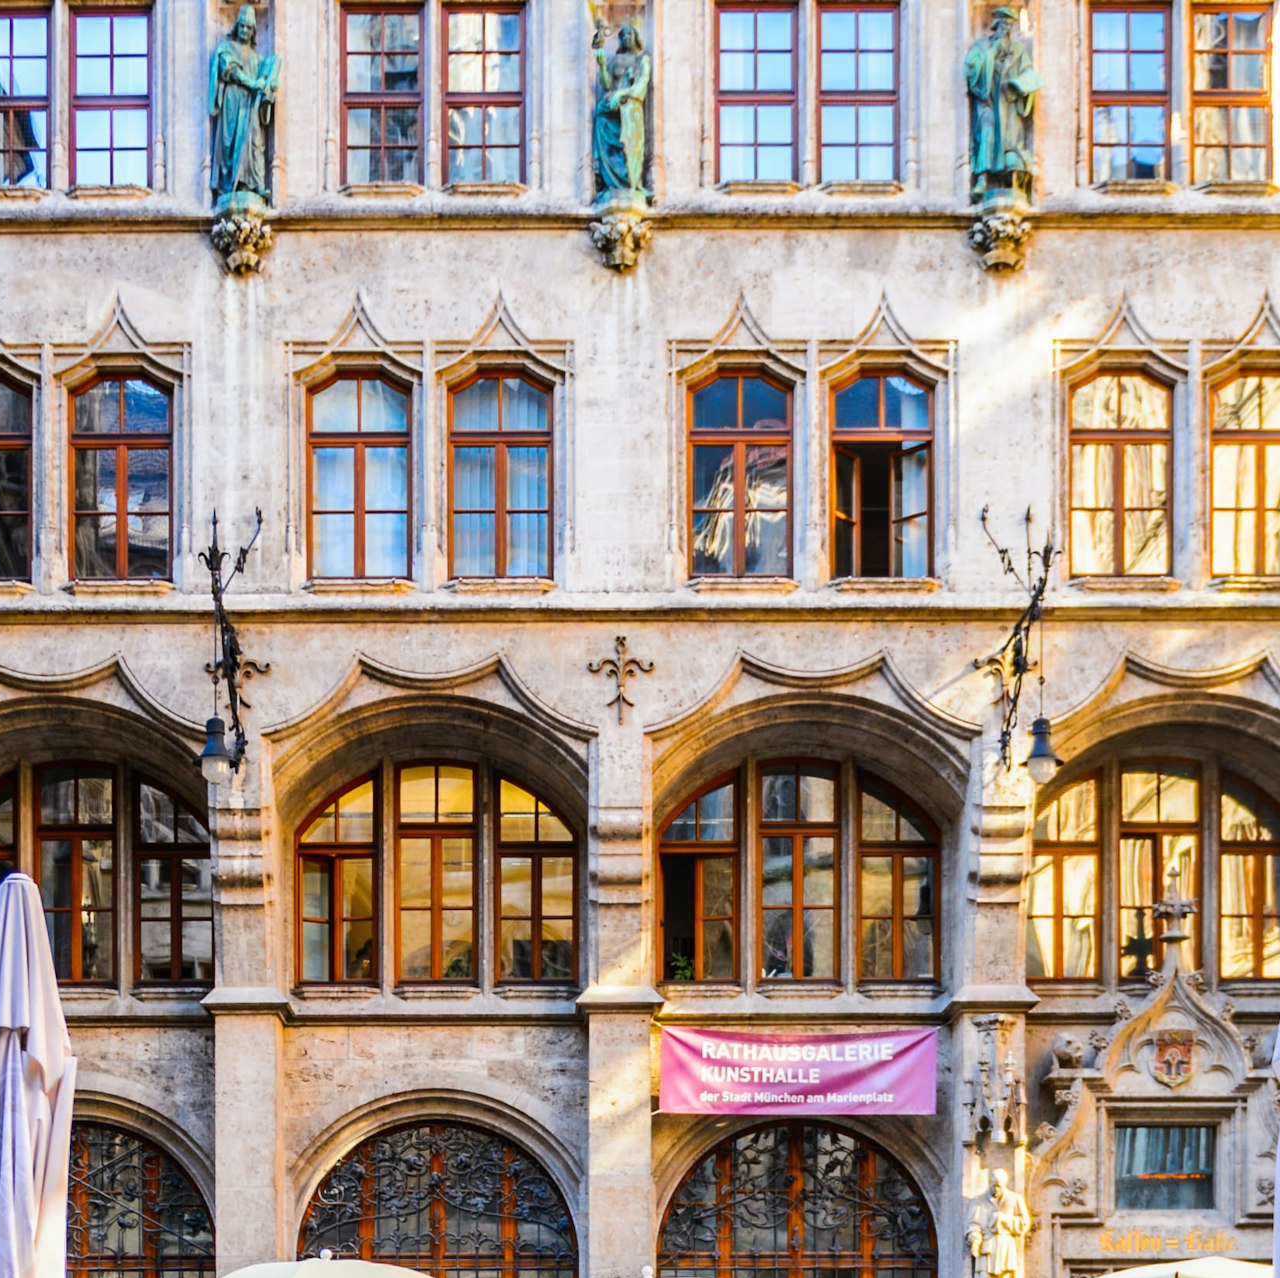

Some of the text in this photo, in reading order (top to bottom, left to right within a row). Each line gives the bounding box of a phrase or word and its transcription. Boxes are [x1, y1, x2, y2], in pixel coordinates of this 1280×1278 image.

[701, 1041, 894, 1062] RATHAUSGALERIE
[700, 1065, 820, 1084] KUNSTHALLE
[699, 1090, 894, 1104] der Stadt München am Marienplatz
